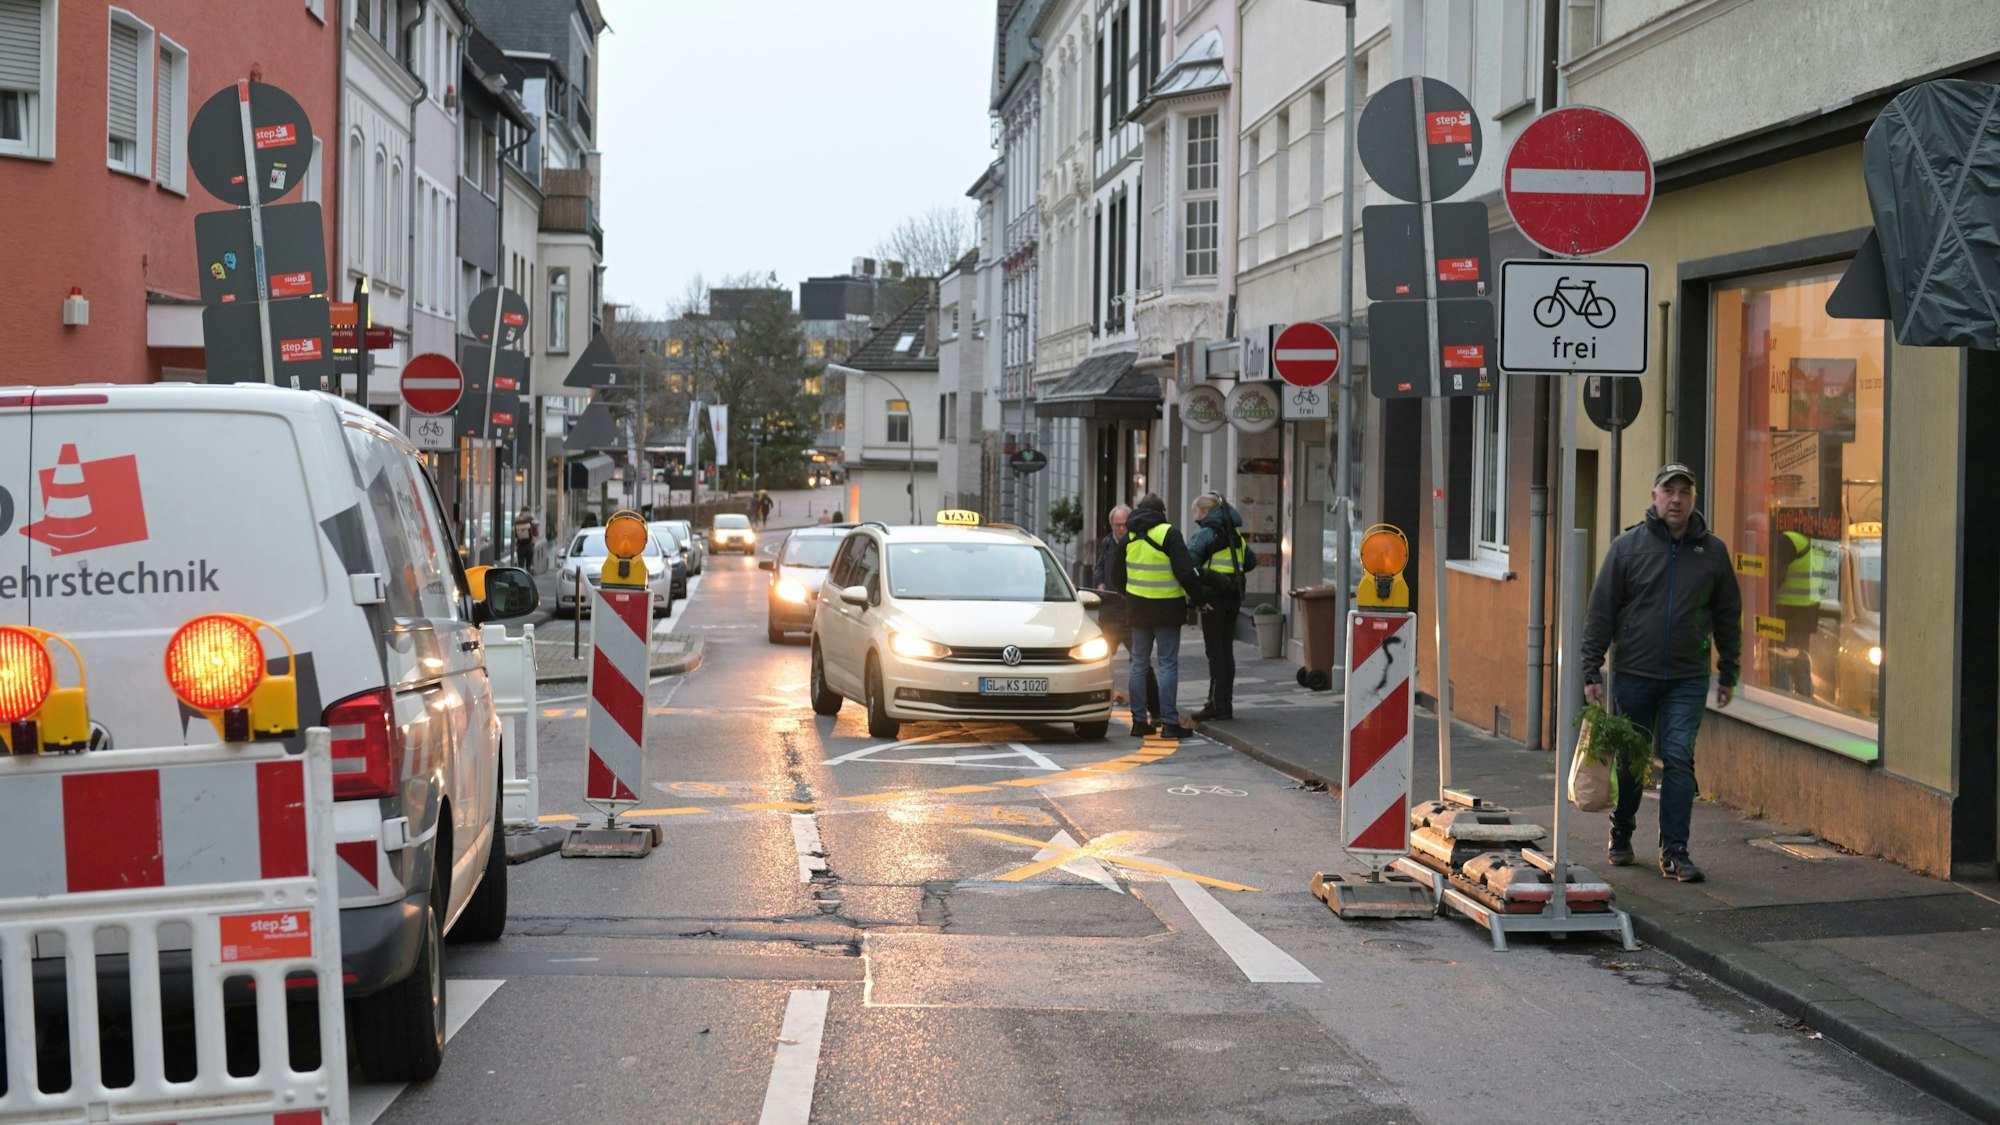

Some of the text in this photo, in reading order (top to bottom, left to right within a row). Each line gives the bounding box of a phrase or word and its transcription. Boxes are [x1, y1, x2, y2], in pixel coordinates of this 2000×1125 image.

[1436, 115, 1457, 126] step
[256, 130, 275, 140] step
[281, 343, 301, 352] step
[1552, 336, 1596, 359] frei
[424, 436, 438, 445] frei
[944, 511, 976, 522] TAXI
[0, 559, 220, 599] ehrstechnik
[986, 679, 1047, 691] GL KS 1020
[250, 919, 279, 933] step
